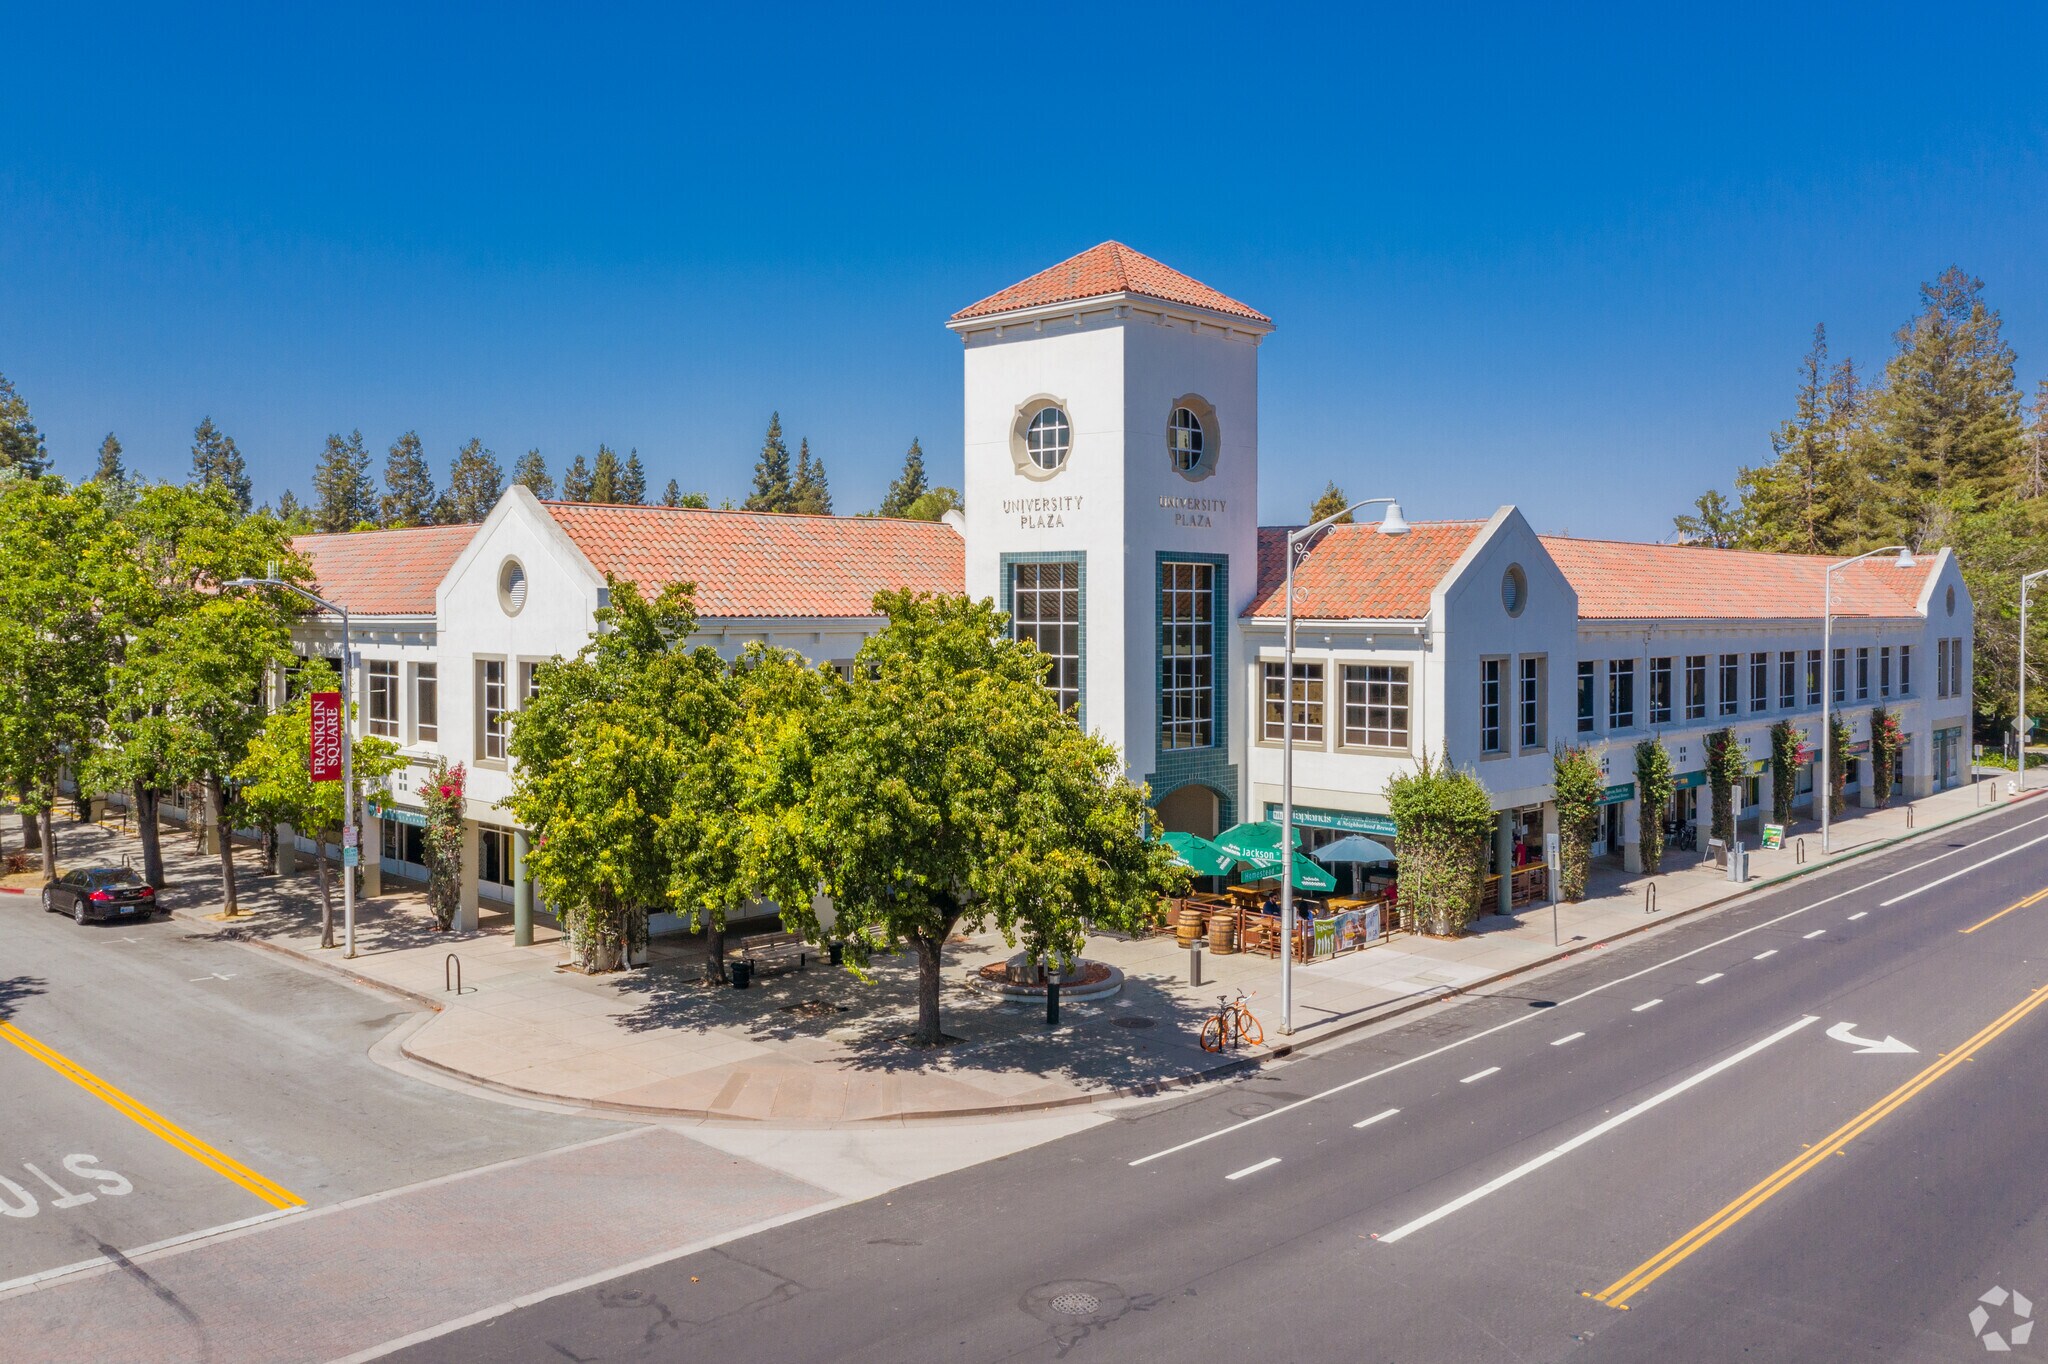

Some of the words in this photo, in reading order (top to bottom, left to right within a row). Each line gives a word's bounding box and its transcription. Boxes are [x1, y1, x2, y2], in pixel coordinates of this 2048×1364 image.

[1003, 495, 1083, 513] UNIVERSITY
[1159, 496, 1226, 512] UNIVERSITY
[1021, 513, 1064, 529] PLAZA
[1175, 513, 1211, 527] PLAZA
[313, 700, 326, 775] FRANKLIN
[327, 707, 340, 766] SQUARE
[1292, 809, 1332, 823] Taplands
[1342, 820, 1376, 831] Neighborhood
[1376, 824, 1396, 833] Brewery
[1241, 848, 1274, 859] Jackson
[1244, 868, 1275, 880] Homestead
[0, 1153, 133, 1218] STO
